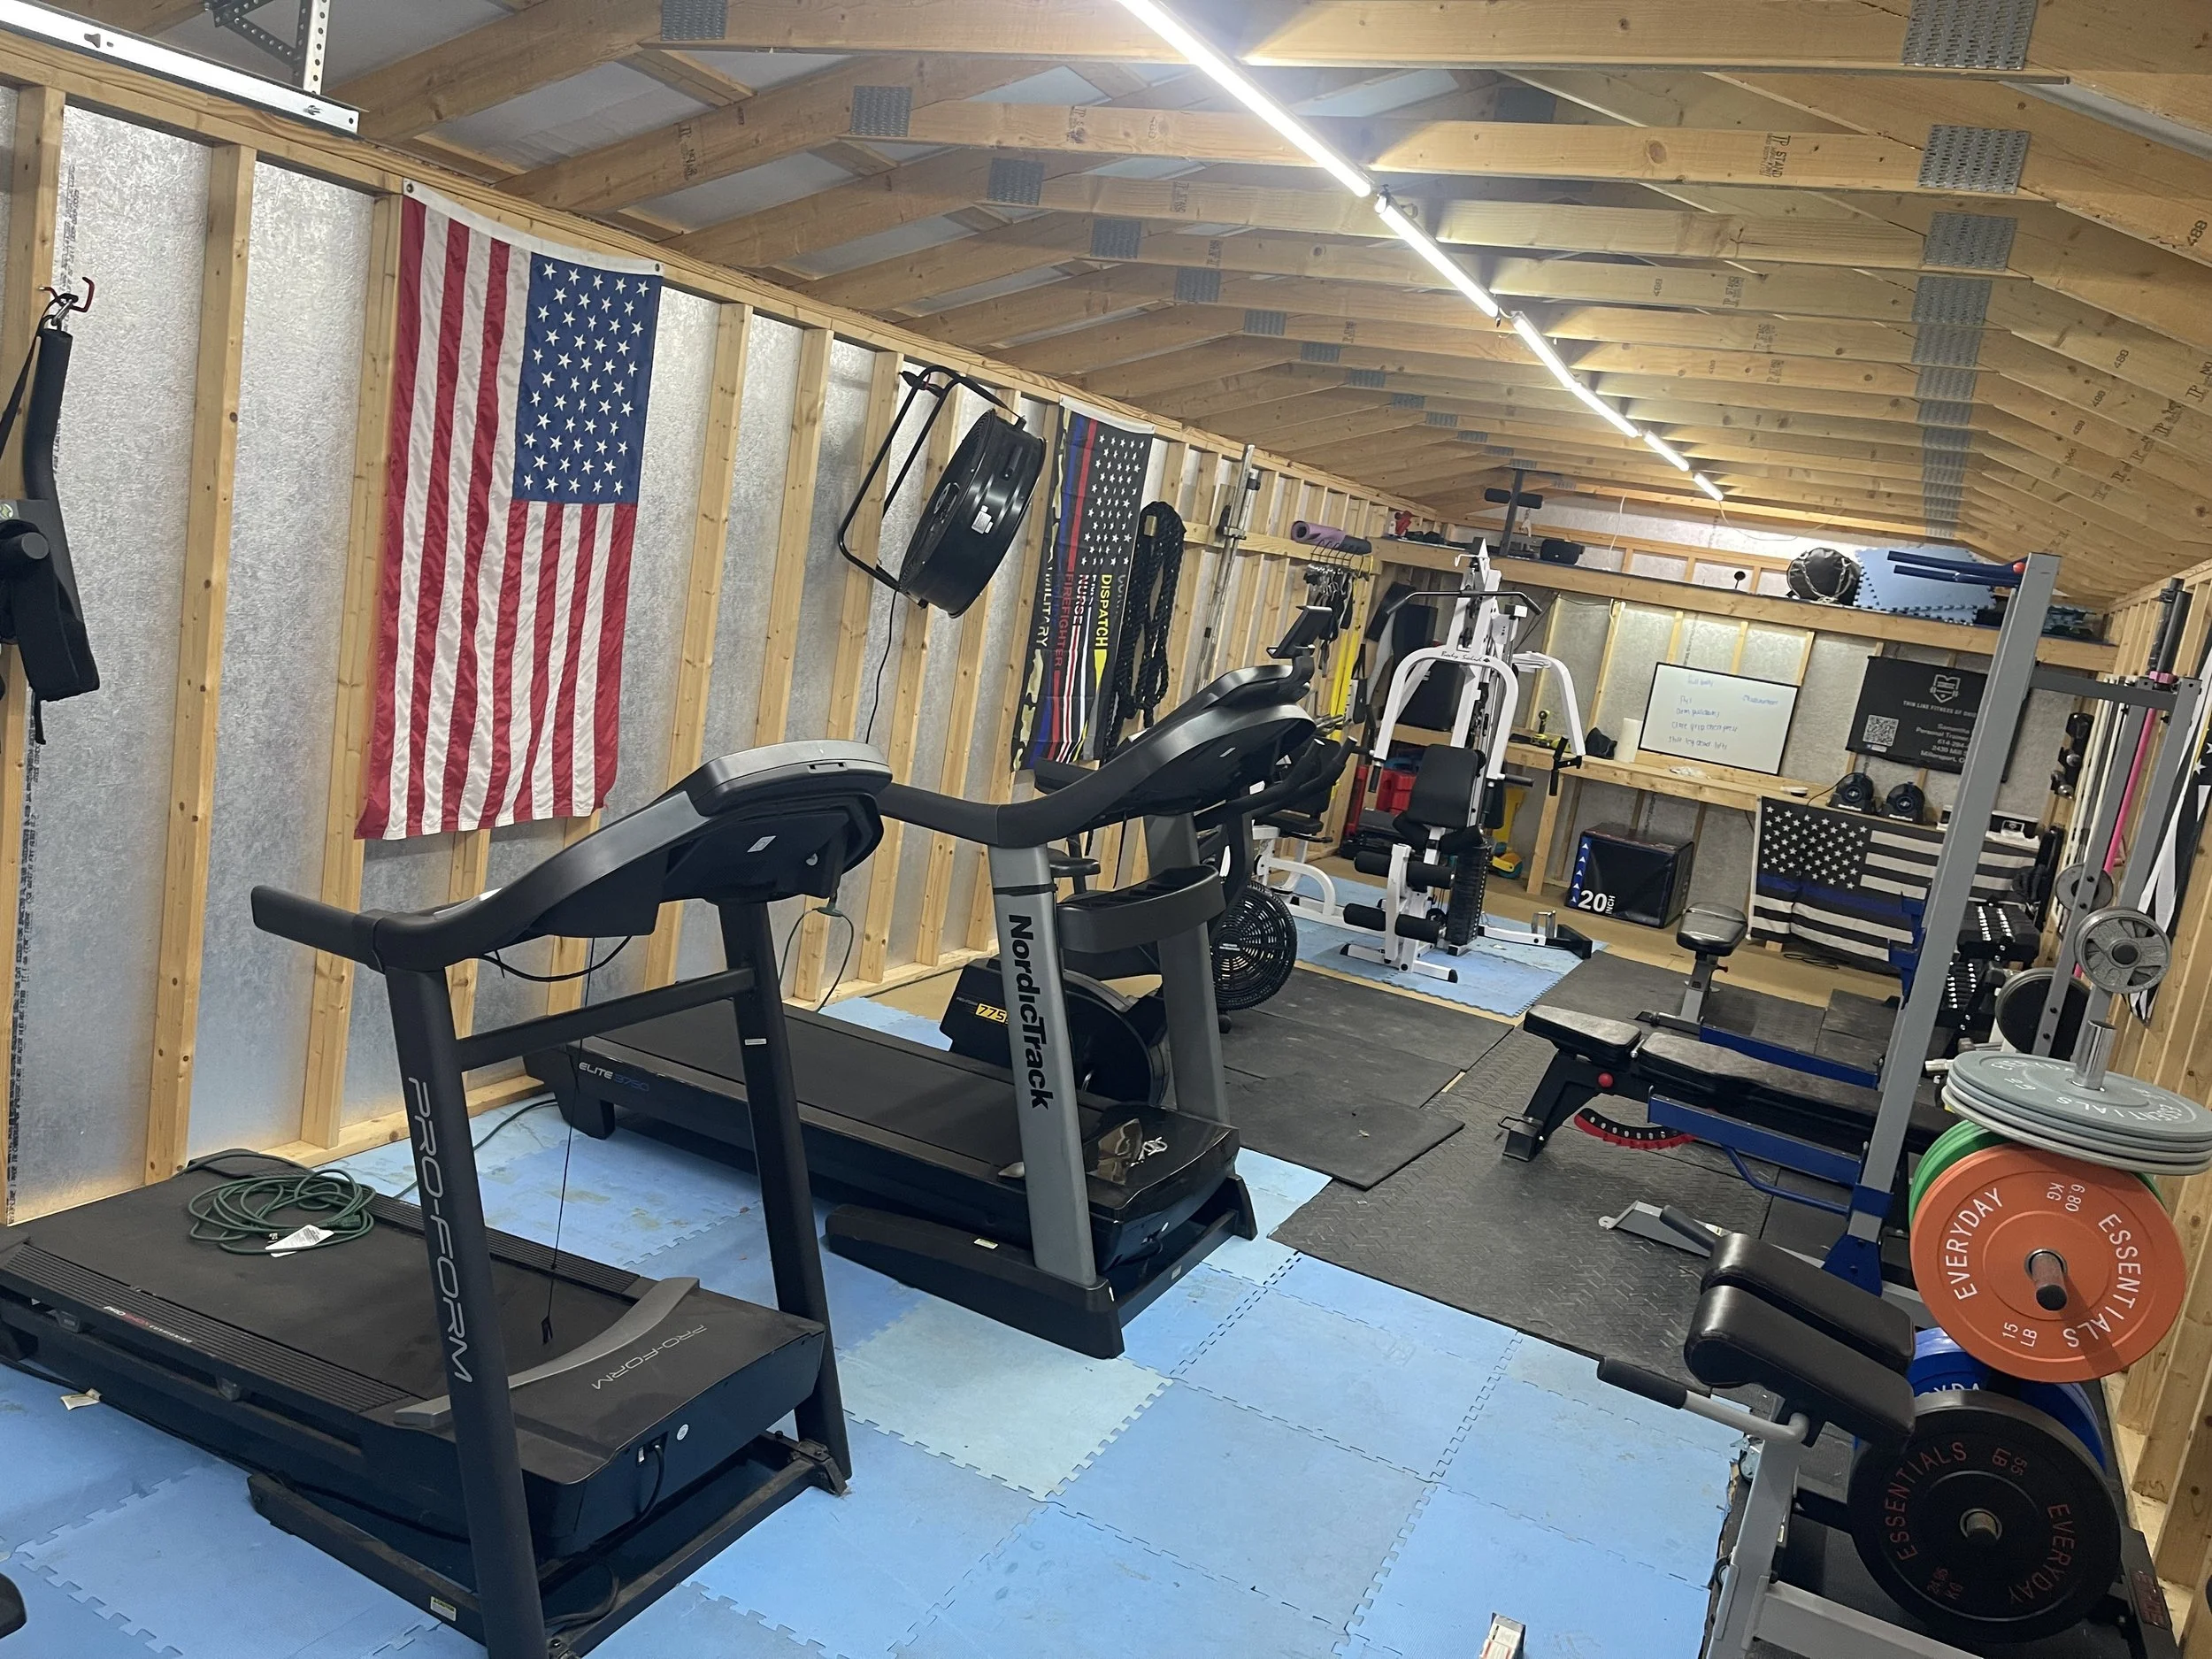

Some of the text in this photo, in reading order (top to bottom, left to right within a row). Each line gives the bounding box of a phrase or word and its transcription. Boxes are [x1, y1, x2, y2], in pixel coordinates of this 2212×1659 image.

[2185, 219, 2208, 247] 488
[1055, 573, 1073, 666] FIREFIGHTER
[1073, 574, 1088, 625] NURSE
[1094, 574, 1111, 647] DISPATCH
[1578, 890, 1616, 916] 20 INCH
[978, 1004, 1005, 1022] 775
[1008, 914, 1054, 1110] NordicTrack
[579, 1062, 613, 1079] ELITE
[2046, 1181, 2065, 1202] KG
[2064, 1183, 2086, 1213] 6.80
[408, 1077, 472, 1384] PRO-FORM
[1945, 1187, 2004, 1302] EVERYDAY
[2062, 1213, 2143, 1349] ESSENTIALS
[2001, 1322, 2020, 1341] 15
[2019, 1328, 2039, 1348] LB
[591, 1324, 708, 1390] PRO-FORM
[1992, 1447, 2012, 1468] LB
[2010, 1457, 2028, 1476] 55
[1885, 1441, 1967, 1561] ESSENTIALS
[2008, 1504, 2076, 1605] EVERYDAY
